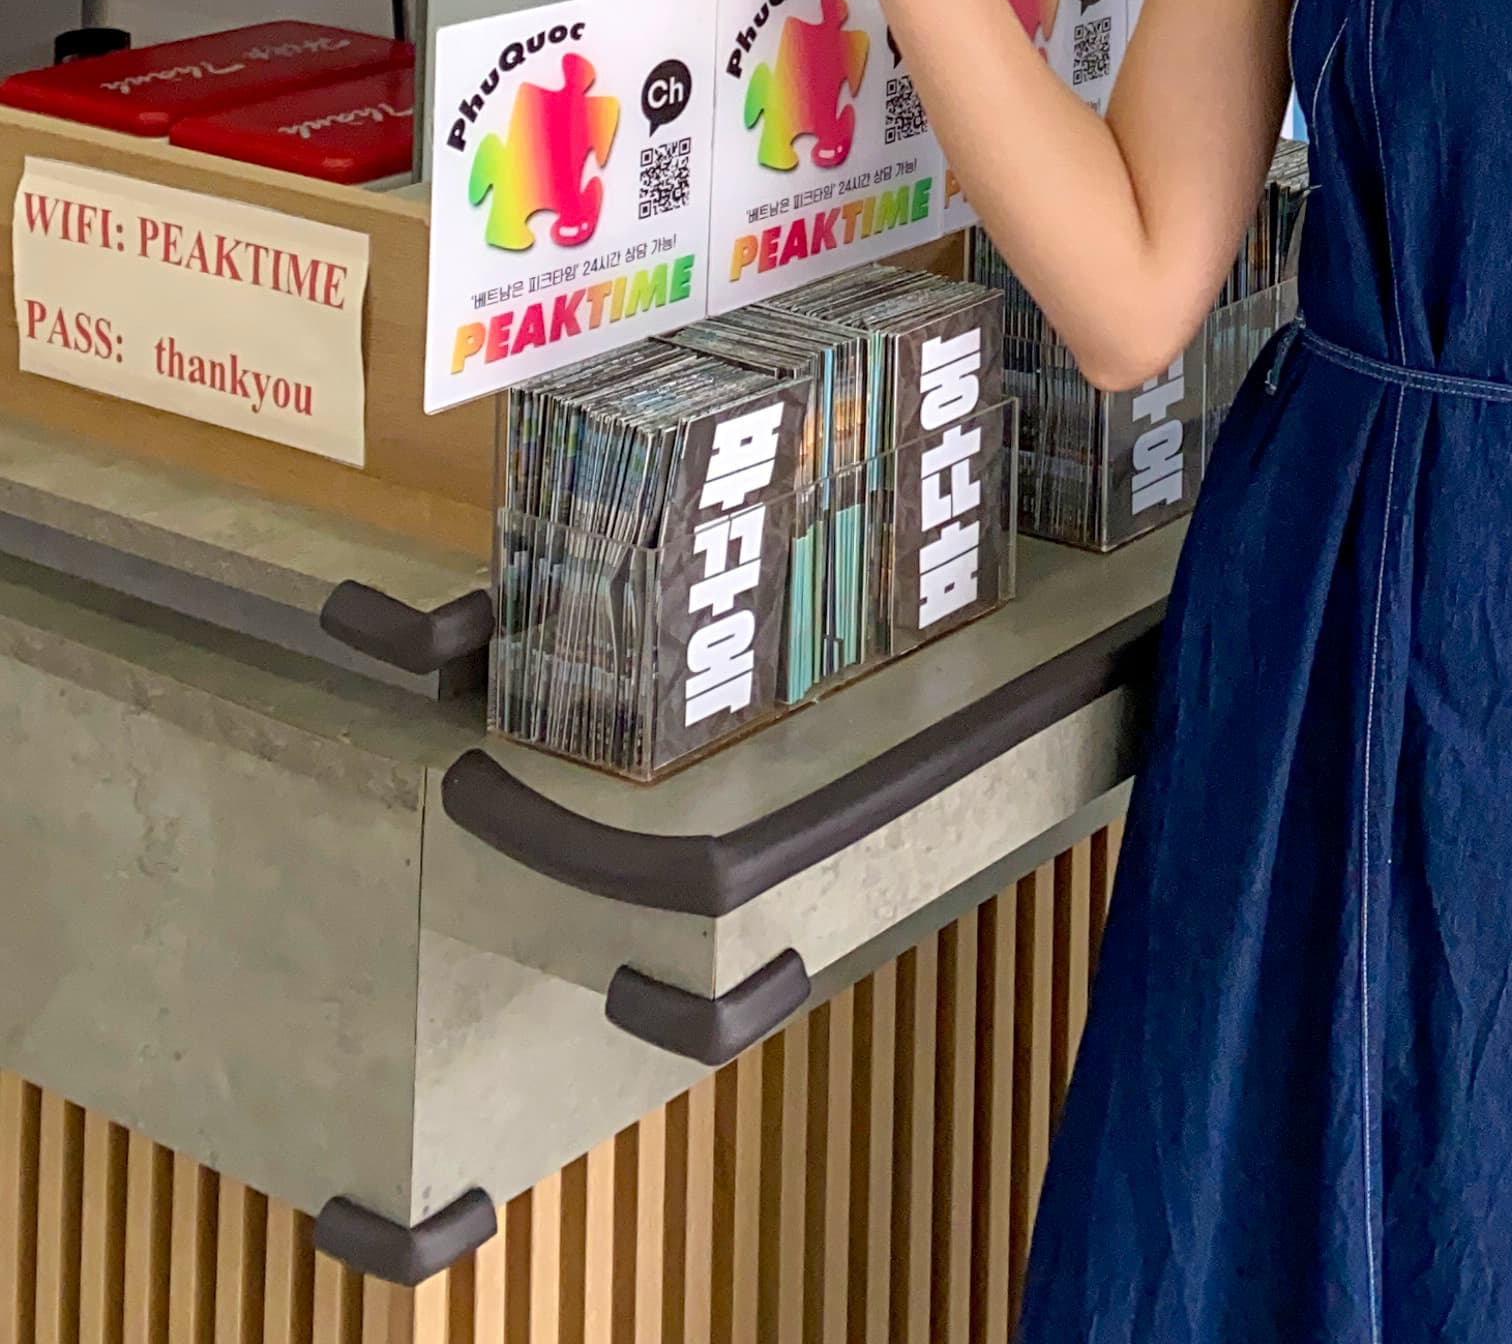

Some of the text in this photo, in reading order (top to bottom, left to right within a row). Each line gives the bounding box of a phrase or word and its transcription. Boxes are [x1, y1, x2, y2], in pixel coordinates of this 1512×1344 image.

[446, 22, 586, 152] PhuQuoc
[647, 77, 685, 109] Ch
[728, 176, 932, 283] PEAKTIME
[838, 173, 871, 195] 24시간
[873, 167, 892, 185] 상담
[895, 157, 918, 177] 가능!
[23, 191, 348, 312] WIFI: PEAKTIME
[583, 251, 621, 276] 24시간
[625, 244, 648, 264] 상담
[651, 233, 677, 254] 가능!
[23, 298, 313, 416] PASS: thankyou
[450, 254, 695, 375] PEAKTIME
